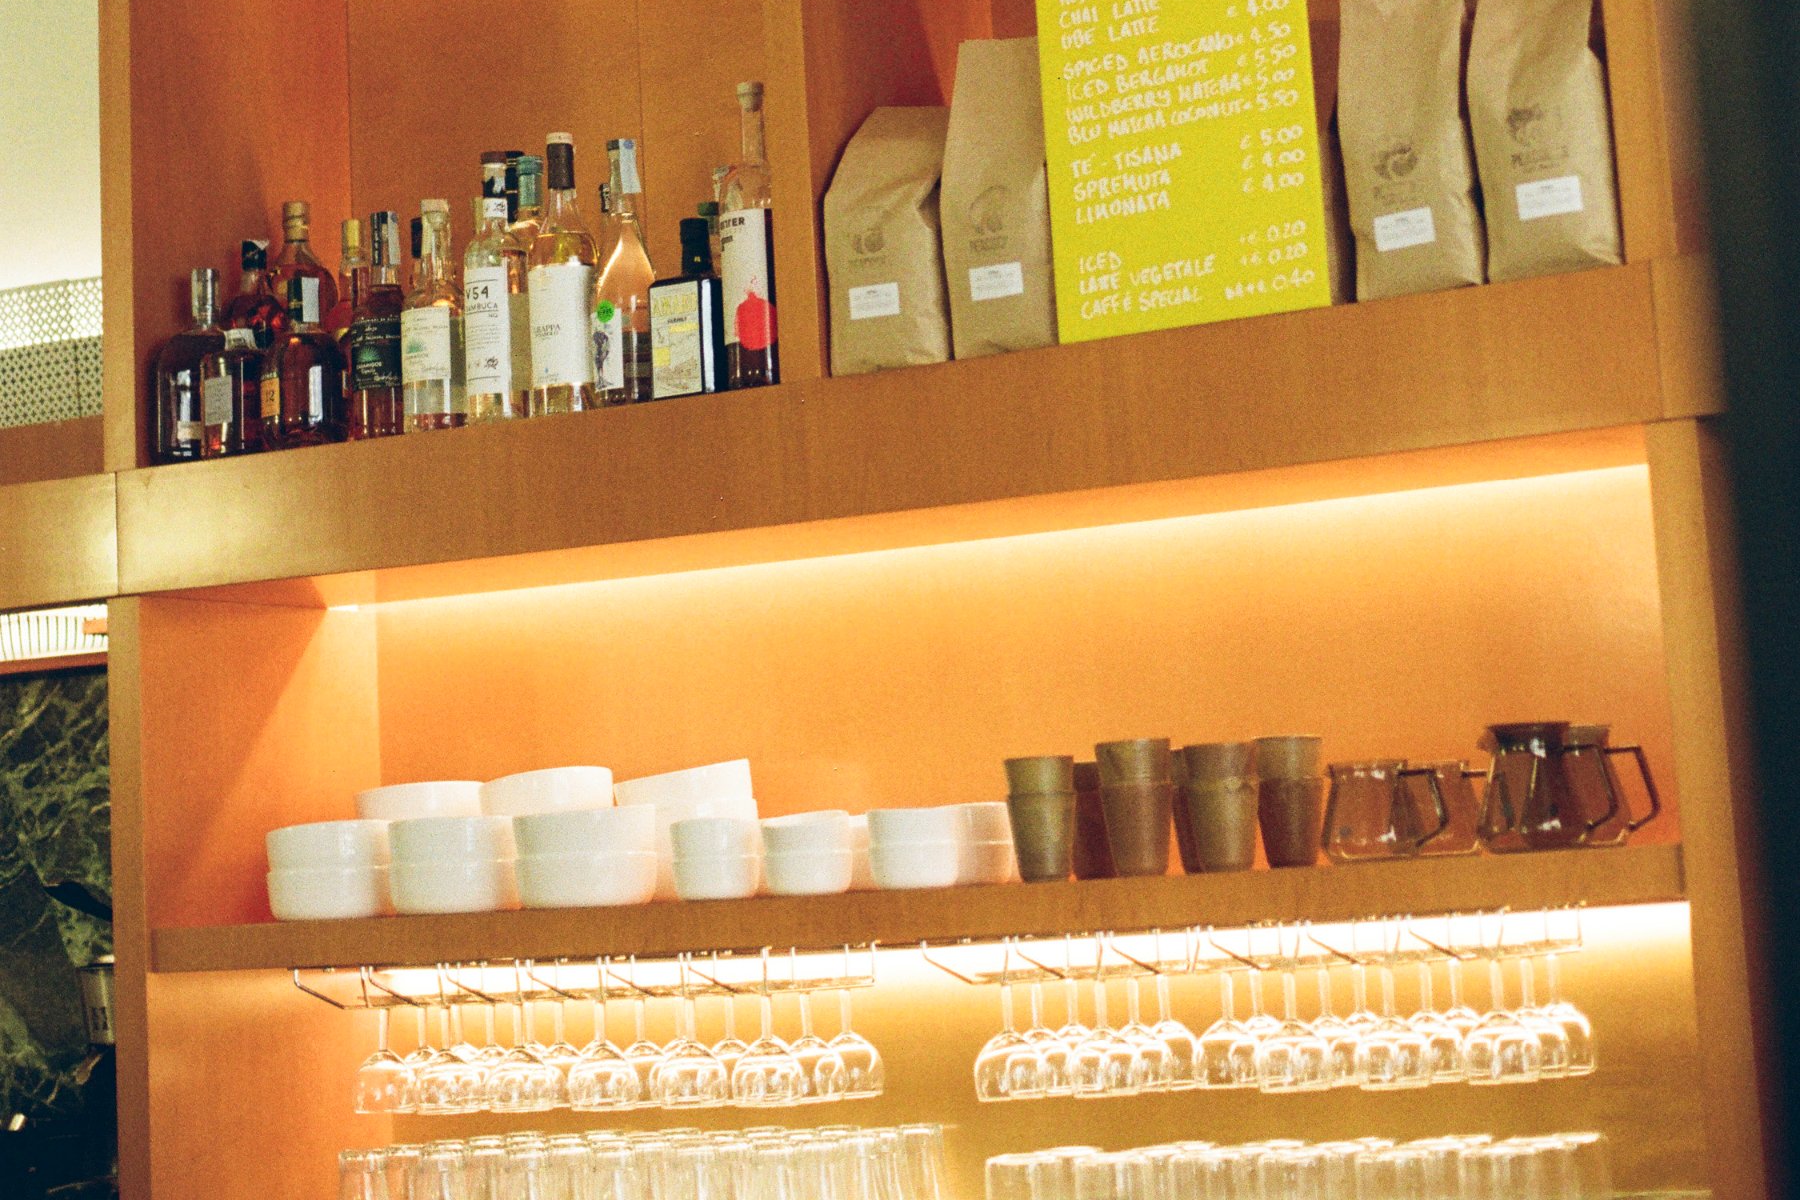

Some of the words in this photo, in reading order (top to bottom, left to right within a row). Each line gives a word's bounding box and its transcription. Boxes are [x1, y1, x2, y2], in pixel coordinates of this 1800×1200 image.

[1059, 6, 1099, 28] CHAI
[1061, 27, 1096, 49] UBE
[1108, 15, 1159, 42] LATTE
[1063, 53, 1129, 80] SPICED
[1066, 78, 1110, 103] ICED
[1066, 89, 1171, 124] WILDBERRY
[1178, 72, 1242, 104] MATCHA
[1108, 110, 1167, 140] MATCHA
[1113, 142, 1182, 171] TISANA
[1073, 169, 1172, 202] SPREMUTA
[1075, 190, 1171, 225] LIMONATA
[1078, 251, 1122, 274] ICED
[1079, 271, 1121, 295] LATTE
[1129, 253, 1217, 287] VEGETALE
